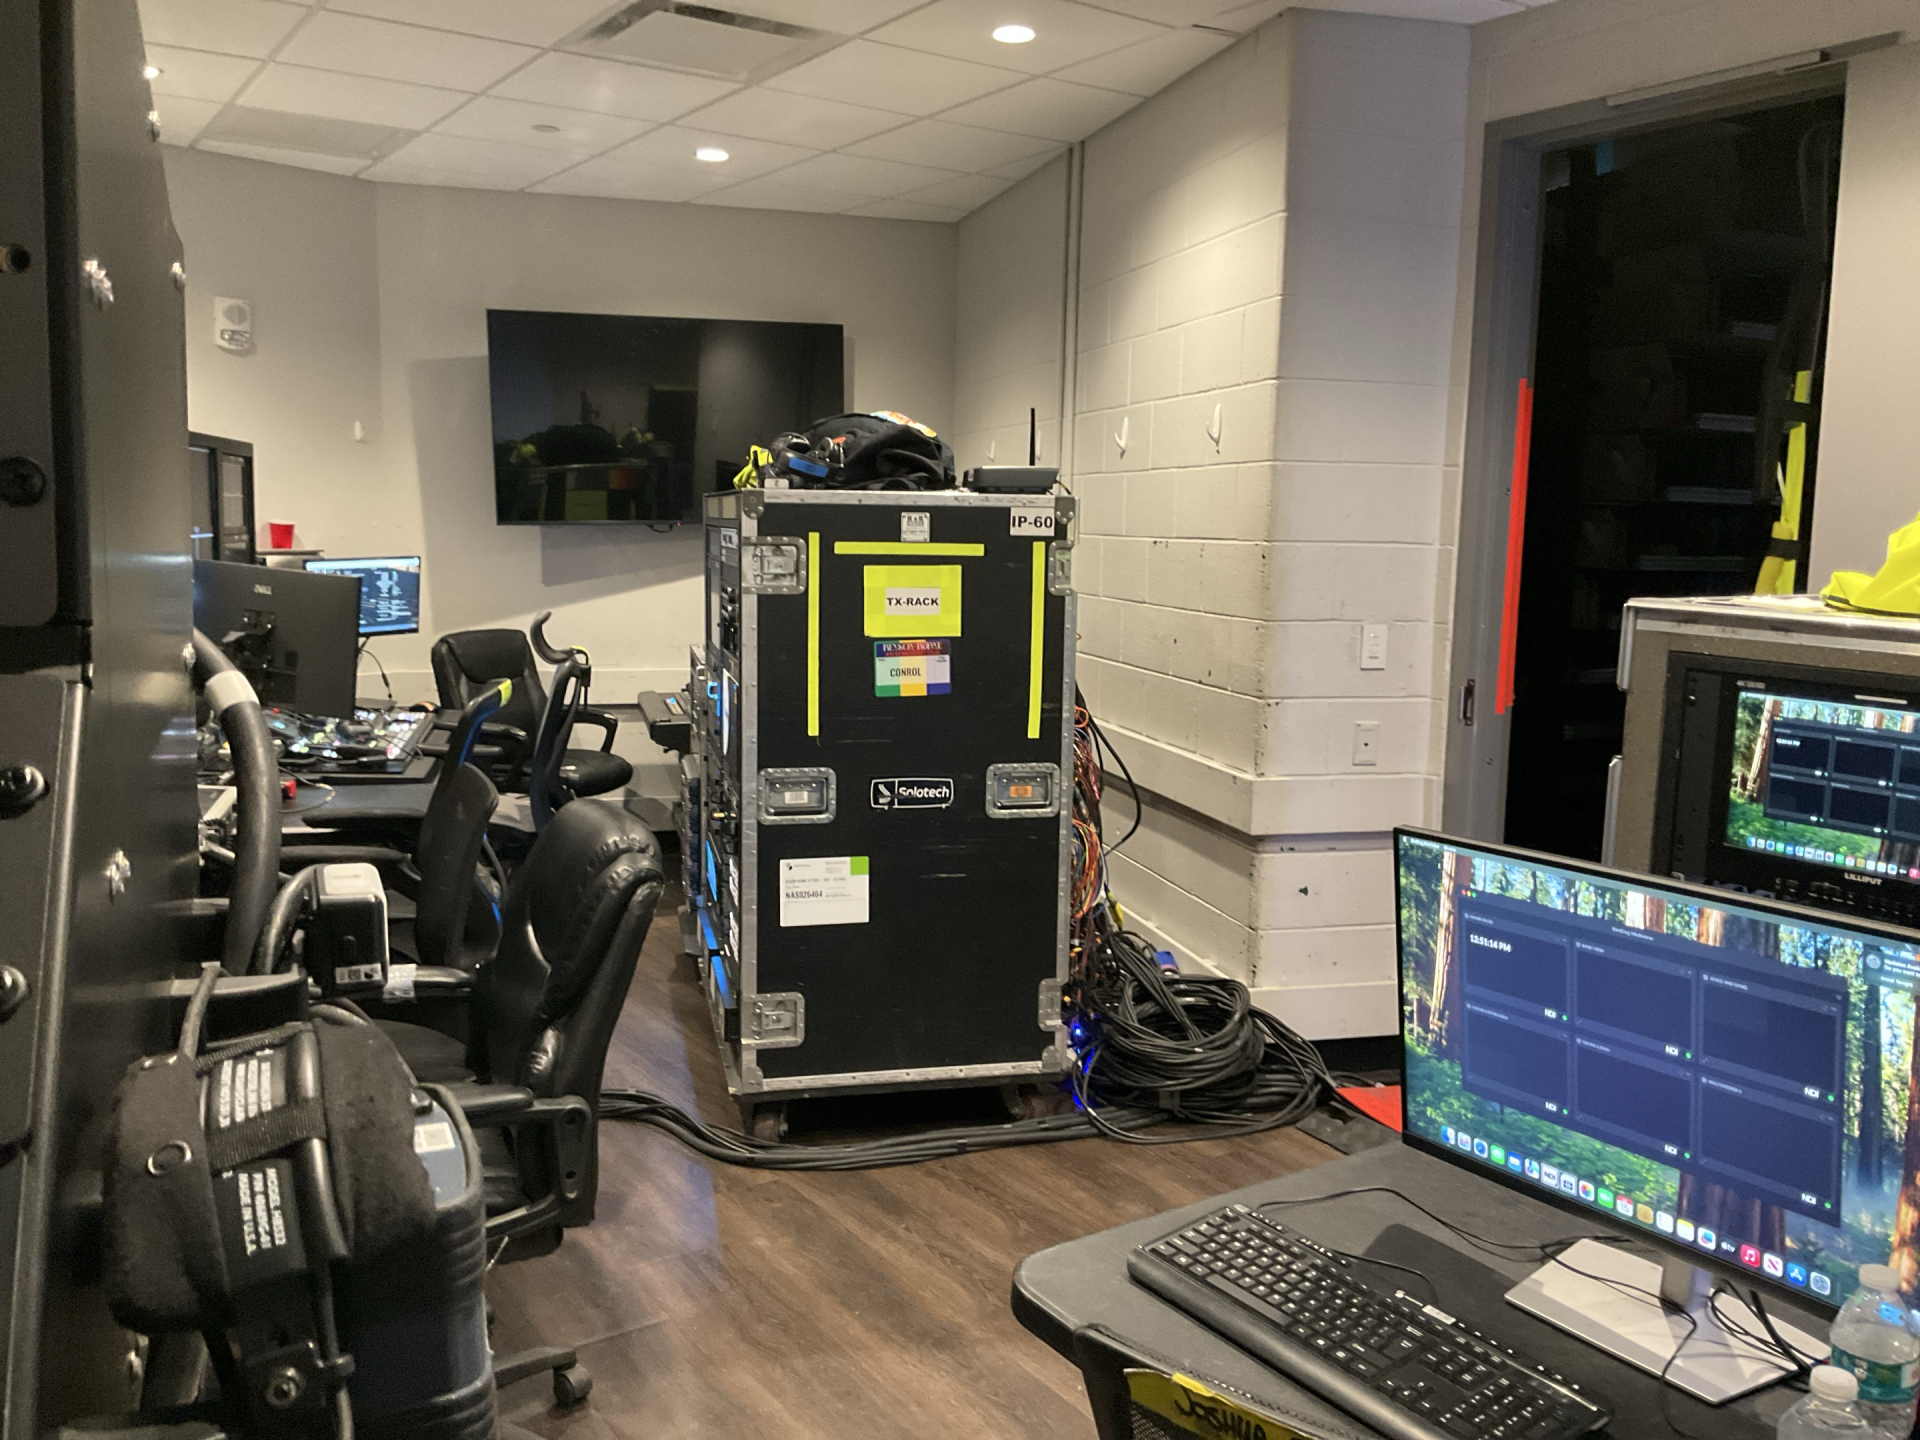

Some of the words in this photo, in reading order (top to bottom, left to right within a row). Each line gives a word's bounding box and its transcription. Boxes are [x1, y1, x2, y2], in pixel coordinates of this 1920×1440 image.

[1012, 515, 1053, 528] IP-60
[887, 597, 939, 606] TX-RACK
[890, 667, 922, 677] CONROL
[1499, 942, 1512, 952] PM
[1544, 1008, 1557, 1019] NDI
[1665, 1045, 1679, 1056] NDI
[1804, 1087, 1819, 1099] NDI
[1545, 1101, 1557, 1112] NDI
[1664, 1144, 1678, 1155] NDI
[238, 1173, 251, 1206] MADE
[1801, 1193, 1816, 1205] NDI
[1621, 1203, 1630, 1212] 15
